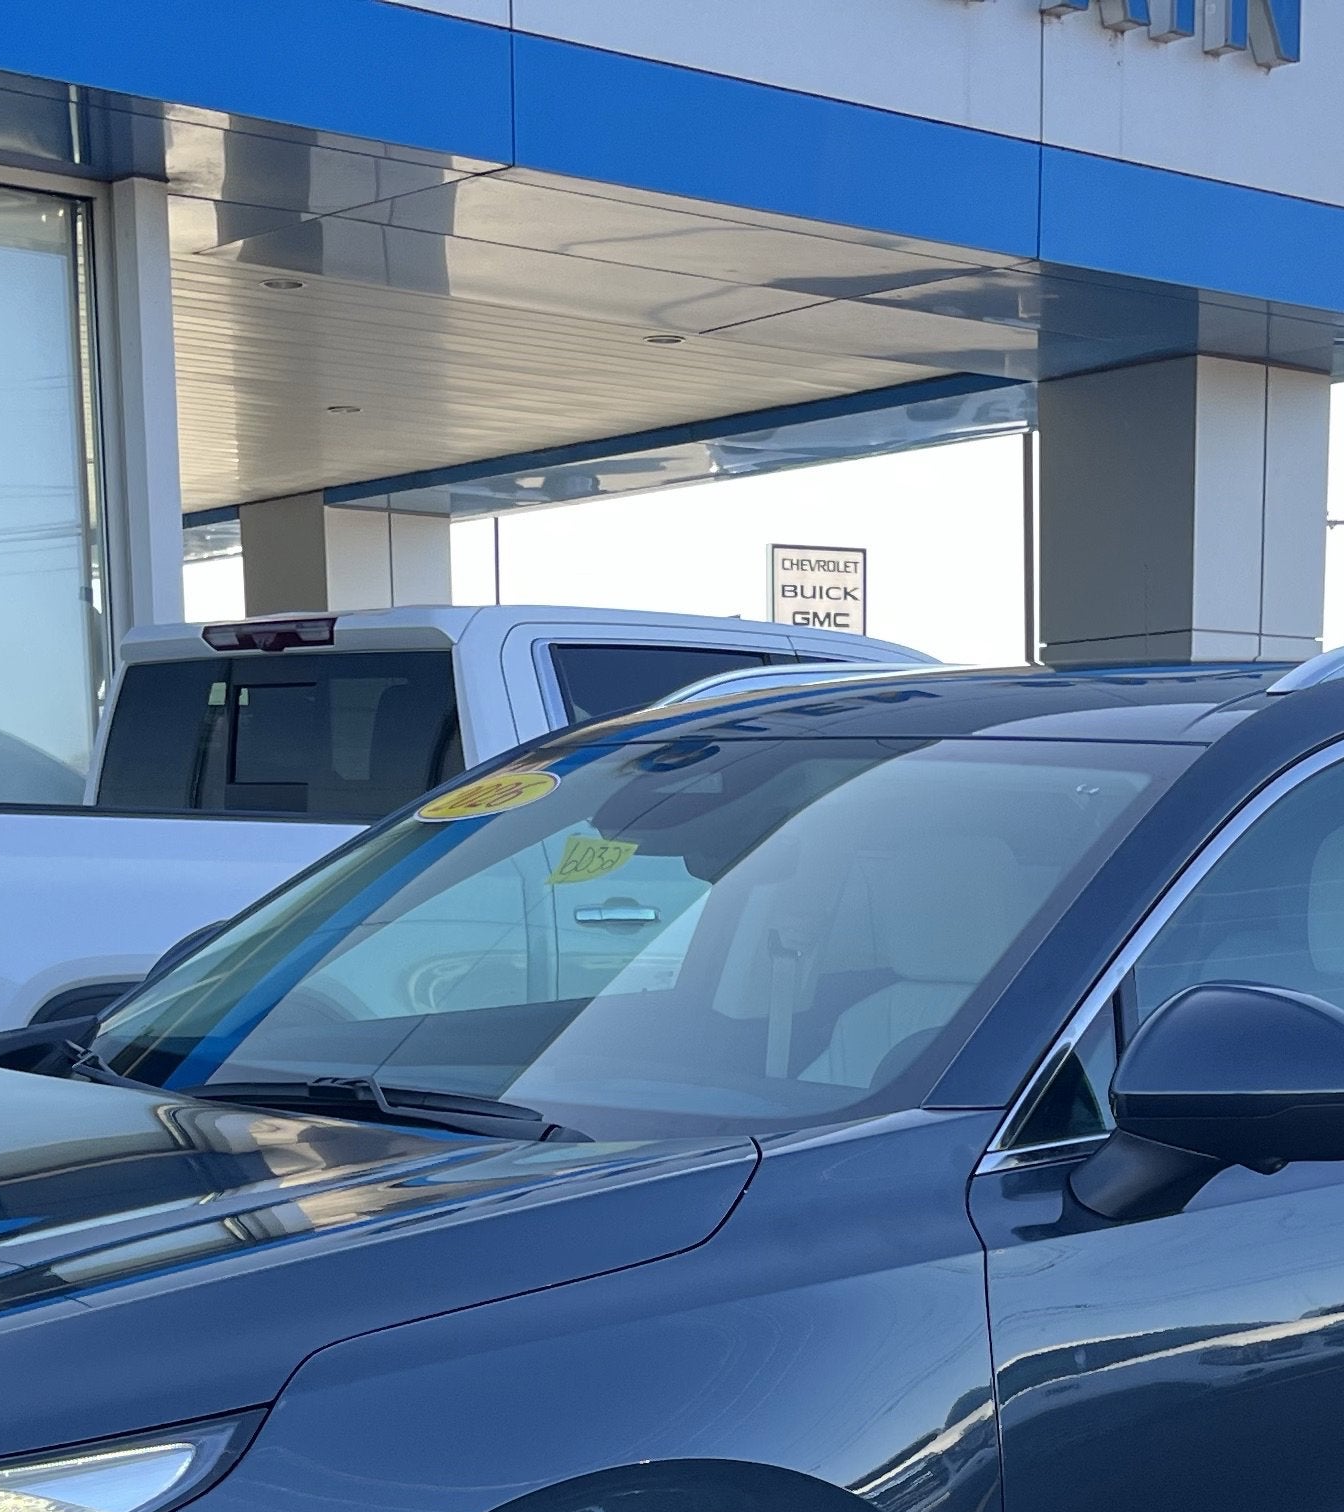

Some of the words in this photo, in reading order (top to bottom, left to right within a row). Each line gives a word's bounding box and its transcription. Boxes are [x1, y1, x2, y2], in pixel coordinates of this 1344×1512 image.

[782, 557, 860, 574] CHEVROLET
[781, 584, 861, 601] BUICK
[792, 611, 850, 628] GMC
